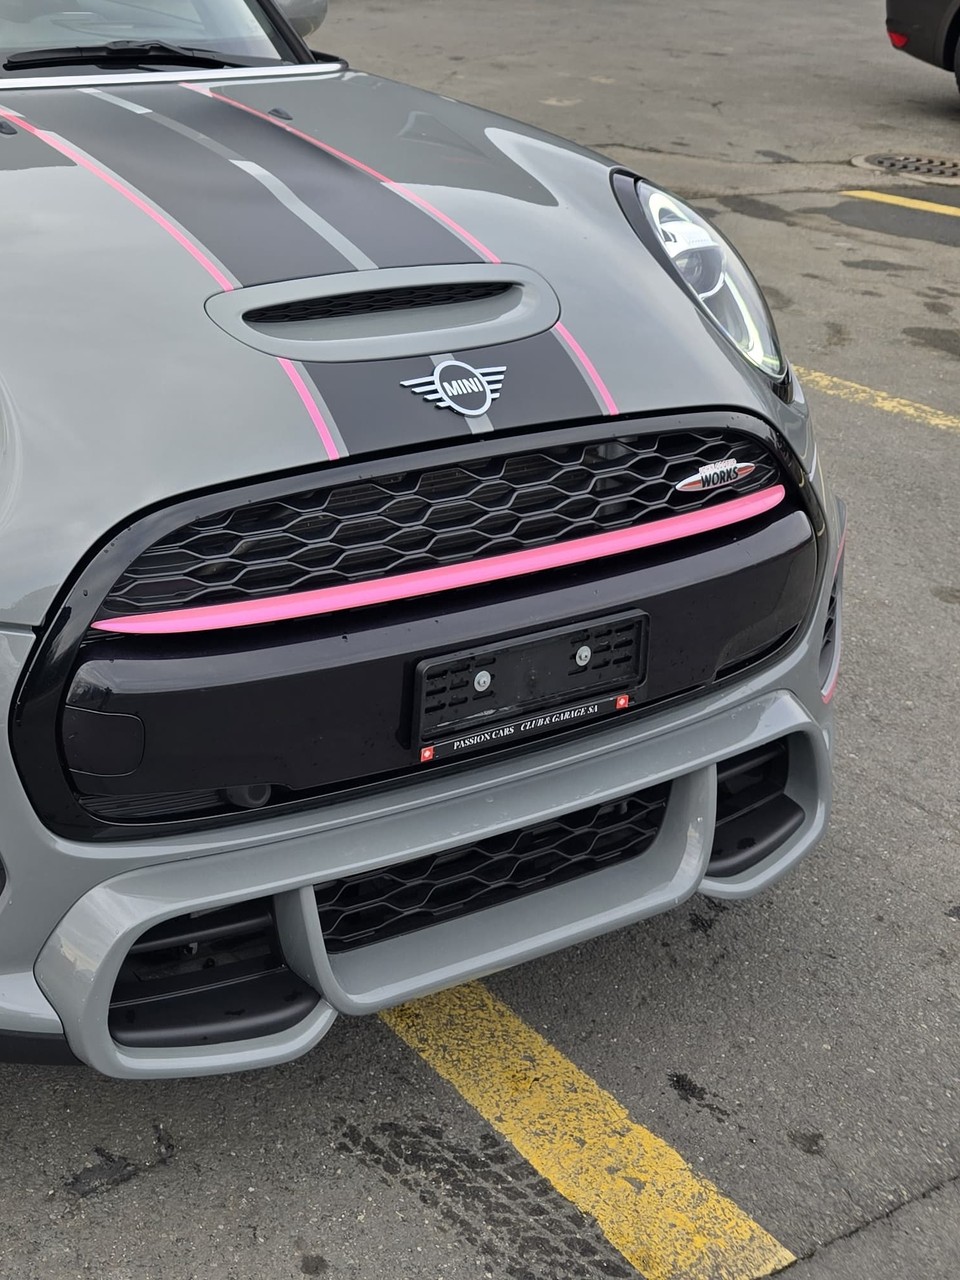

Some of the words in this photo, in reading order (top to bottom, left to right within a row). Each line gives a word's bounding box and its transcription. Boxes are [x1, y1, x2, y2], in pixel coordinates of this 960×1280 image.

[442, 377, 483, 396] MINI
[701, 466, 738, 488] WORKS
[453, 732, 491, 750] PASSION
[491, 726, 515, 739] CARS
[552, 707, 587, 723] GARAGE
[587, 704, 598, 714] SA
